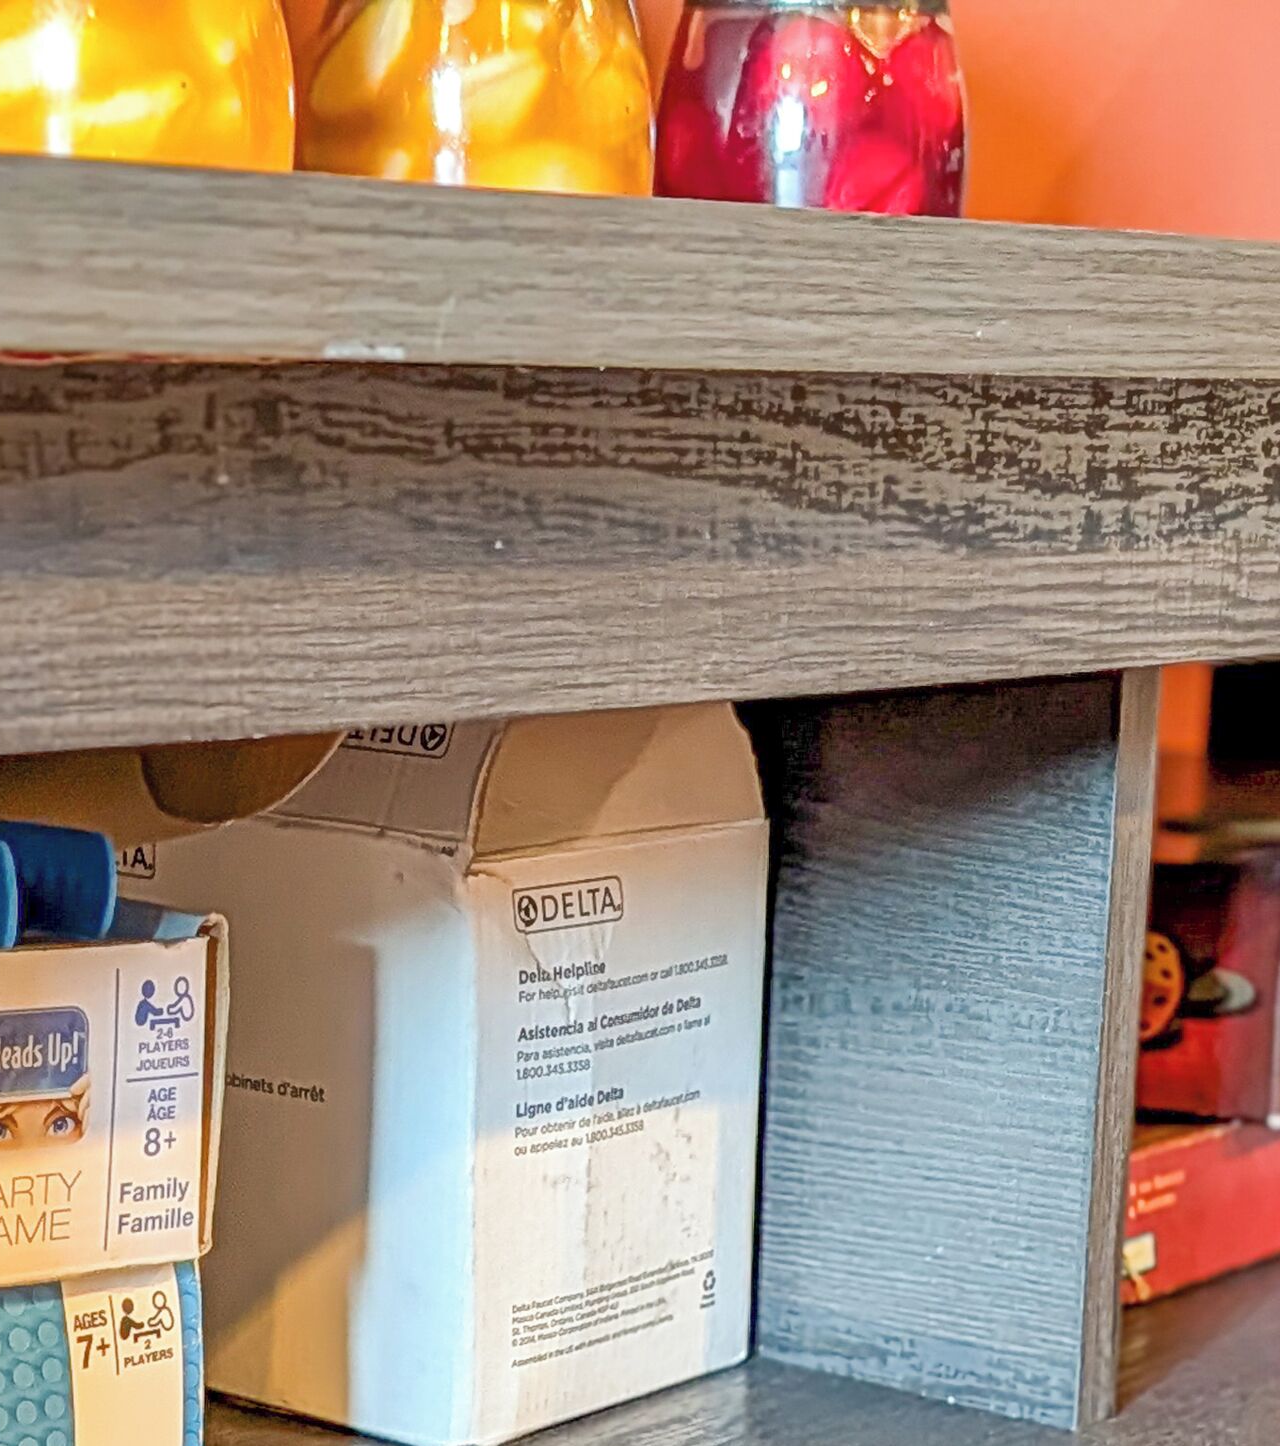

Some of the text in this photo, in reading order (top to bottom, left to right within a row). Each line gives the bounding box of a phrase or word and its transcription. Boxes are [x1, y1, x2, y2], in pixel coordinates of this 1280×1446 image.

[542, 886, 618, 922] DELTA
[519, 960, 606, 985] Delta Helpline
[519, 989, 536, 1003] For
[518, 995, 702, 1043] Asistencia al Consumidor de Delta
[47, 1031, 80, 1073] Up!
[138, 1038, 190, 1054] PLAYERS
[517, 1050, 540, 1063] Para
[136, 1055, 191, 1072] JOUEURS
[516, 1058, 591, 1081] 1.800.345.3358
[148, 1087, 177, 1103] AGE
[225, 1072, 274, 1095] obinets
[516, 1086, 625, 1119] Ligne d'aide Delta
[515, 1125, 538, 1140] Pour
[540, 1118, 577, 1135] obtenir
[579, 1114, 592, 1129] de
[143, 1127, 177, 1157] 8+
[515, 1145, 528, 1157] ou
[529, 1136, 570, 1153] appelez
[571, 1136, 584, 1148] au
[119, 1177, 190, 1203] Family
[117, 1208, 195, 1235] Famille
[73, 1309, 108, 1333] AGES
[75, 1334, 111, 1370] 7+
[144, 1338, 152, 1350] 2
[123, 1347, 174, 1369] PLAYERS
